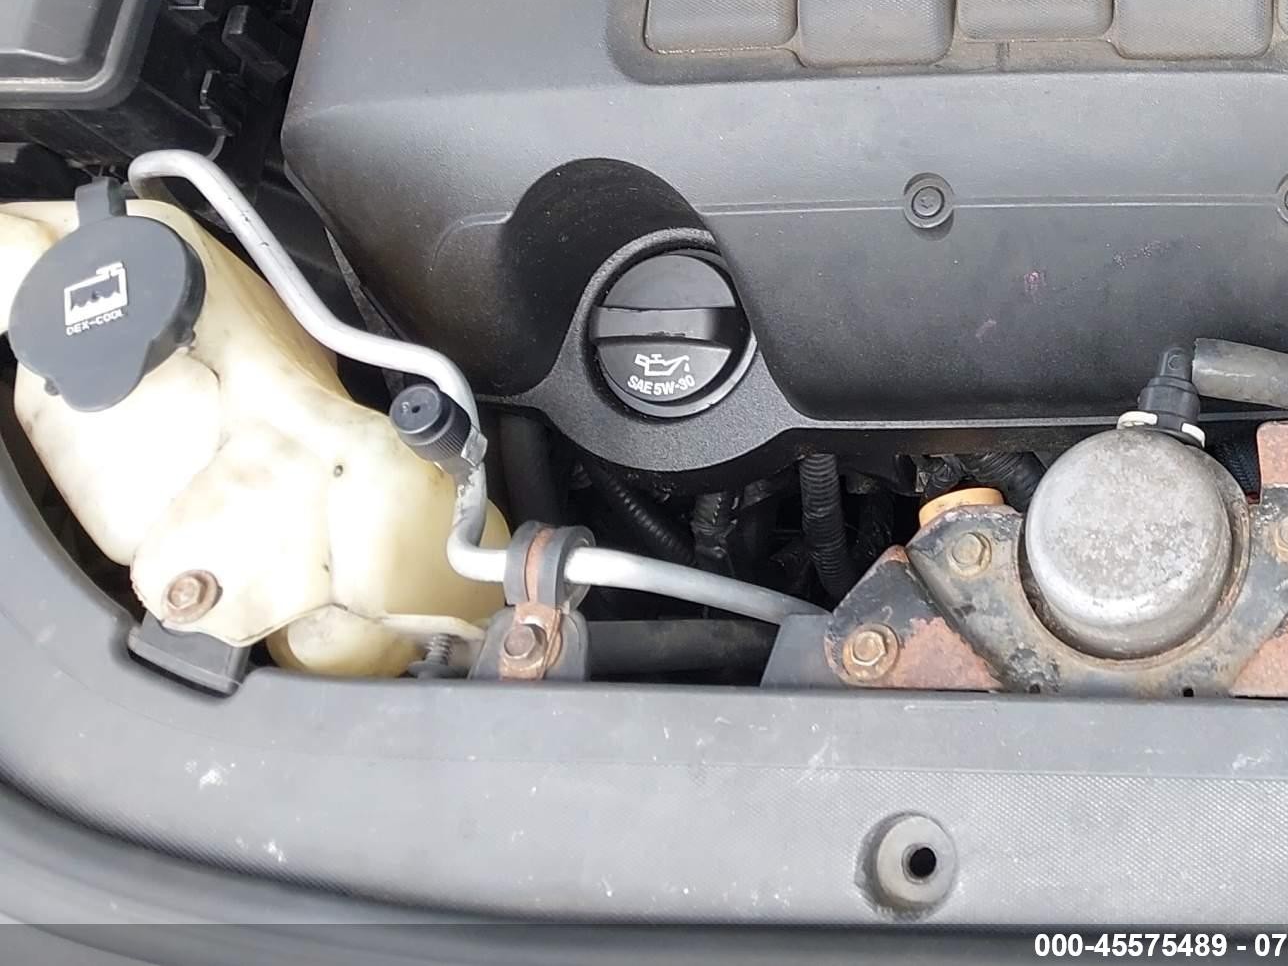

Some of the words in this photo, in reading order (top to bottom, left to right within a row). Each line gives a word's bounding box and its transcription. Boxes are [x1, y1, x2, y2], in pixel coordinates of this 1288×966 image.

[65, 308, 124, 337] DEX-COOL
[627, 374, 652, 396] SAE
[653, 374, 696, 396] 5W-30
